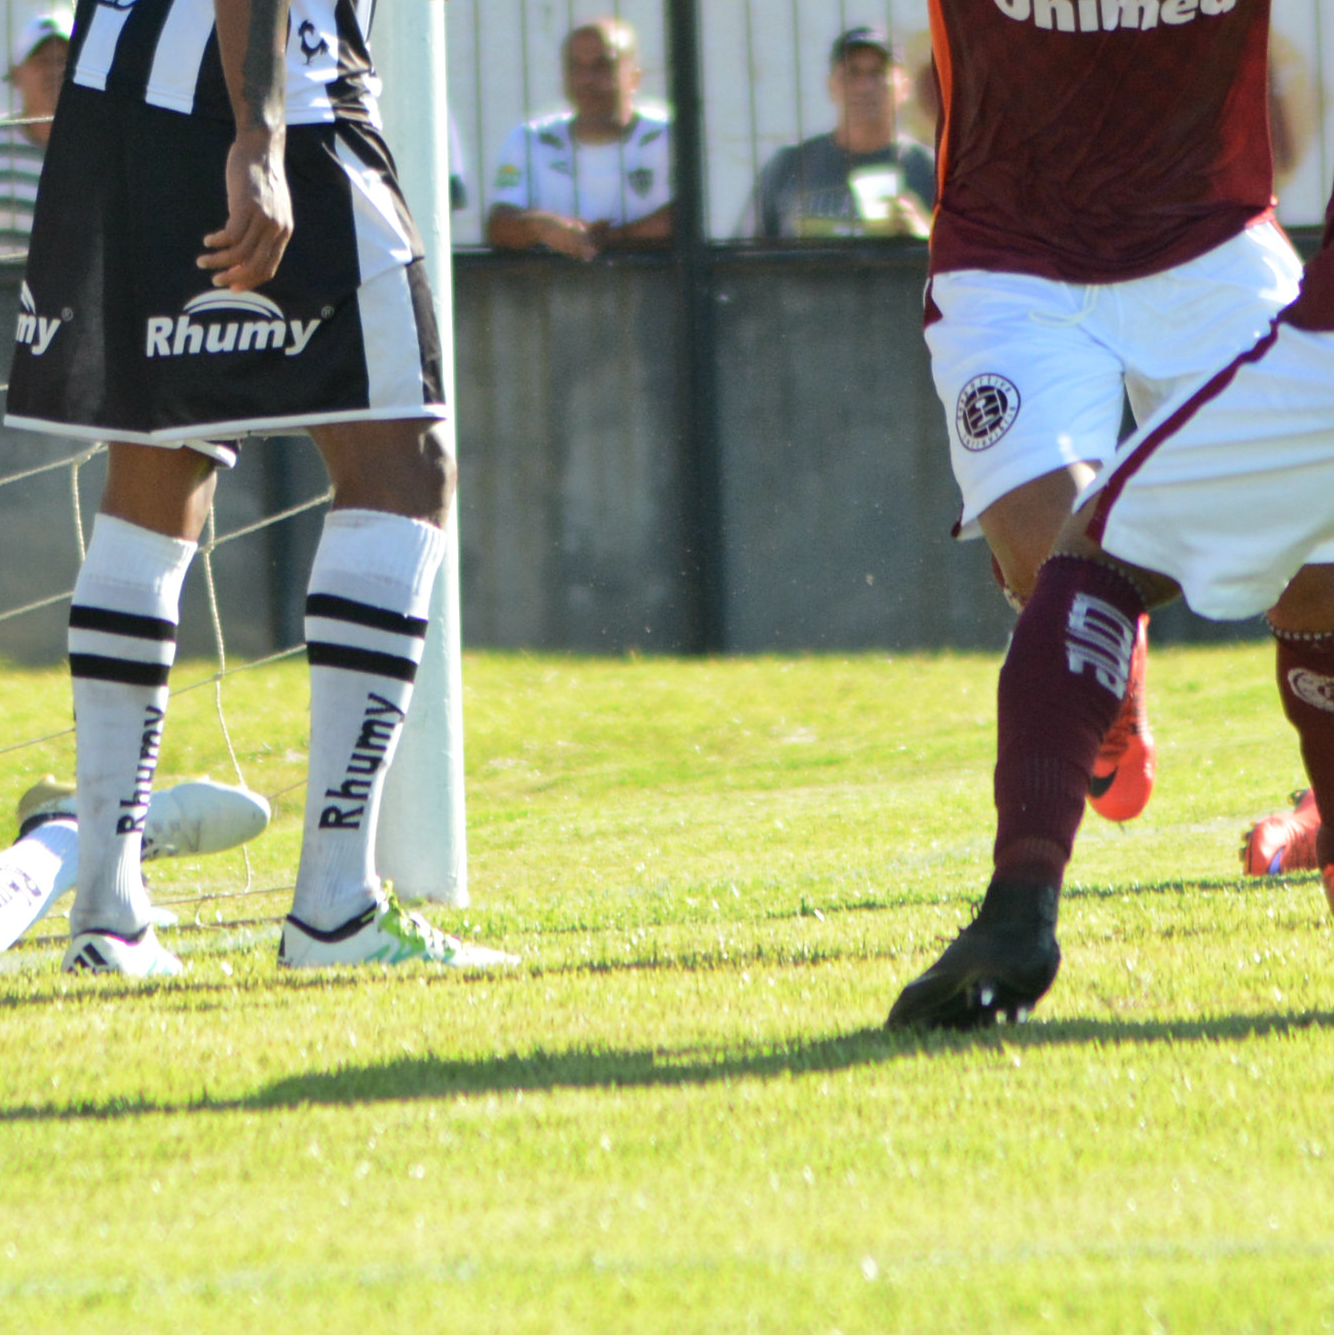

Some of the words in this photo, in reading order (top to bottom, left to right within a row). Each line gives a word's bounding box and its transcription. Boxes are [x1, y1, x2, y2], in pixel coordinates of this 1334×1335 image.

[146, 314, 322, 357] Rhumy
[116, 705, 165, 836] Rhumy
[319, 692, 407, 830] Rhumy
